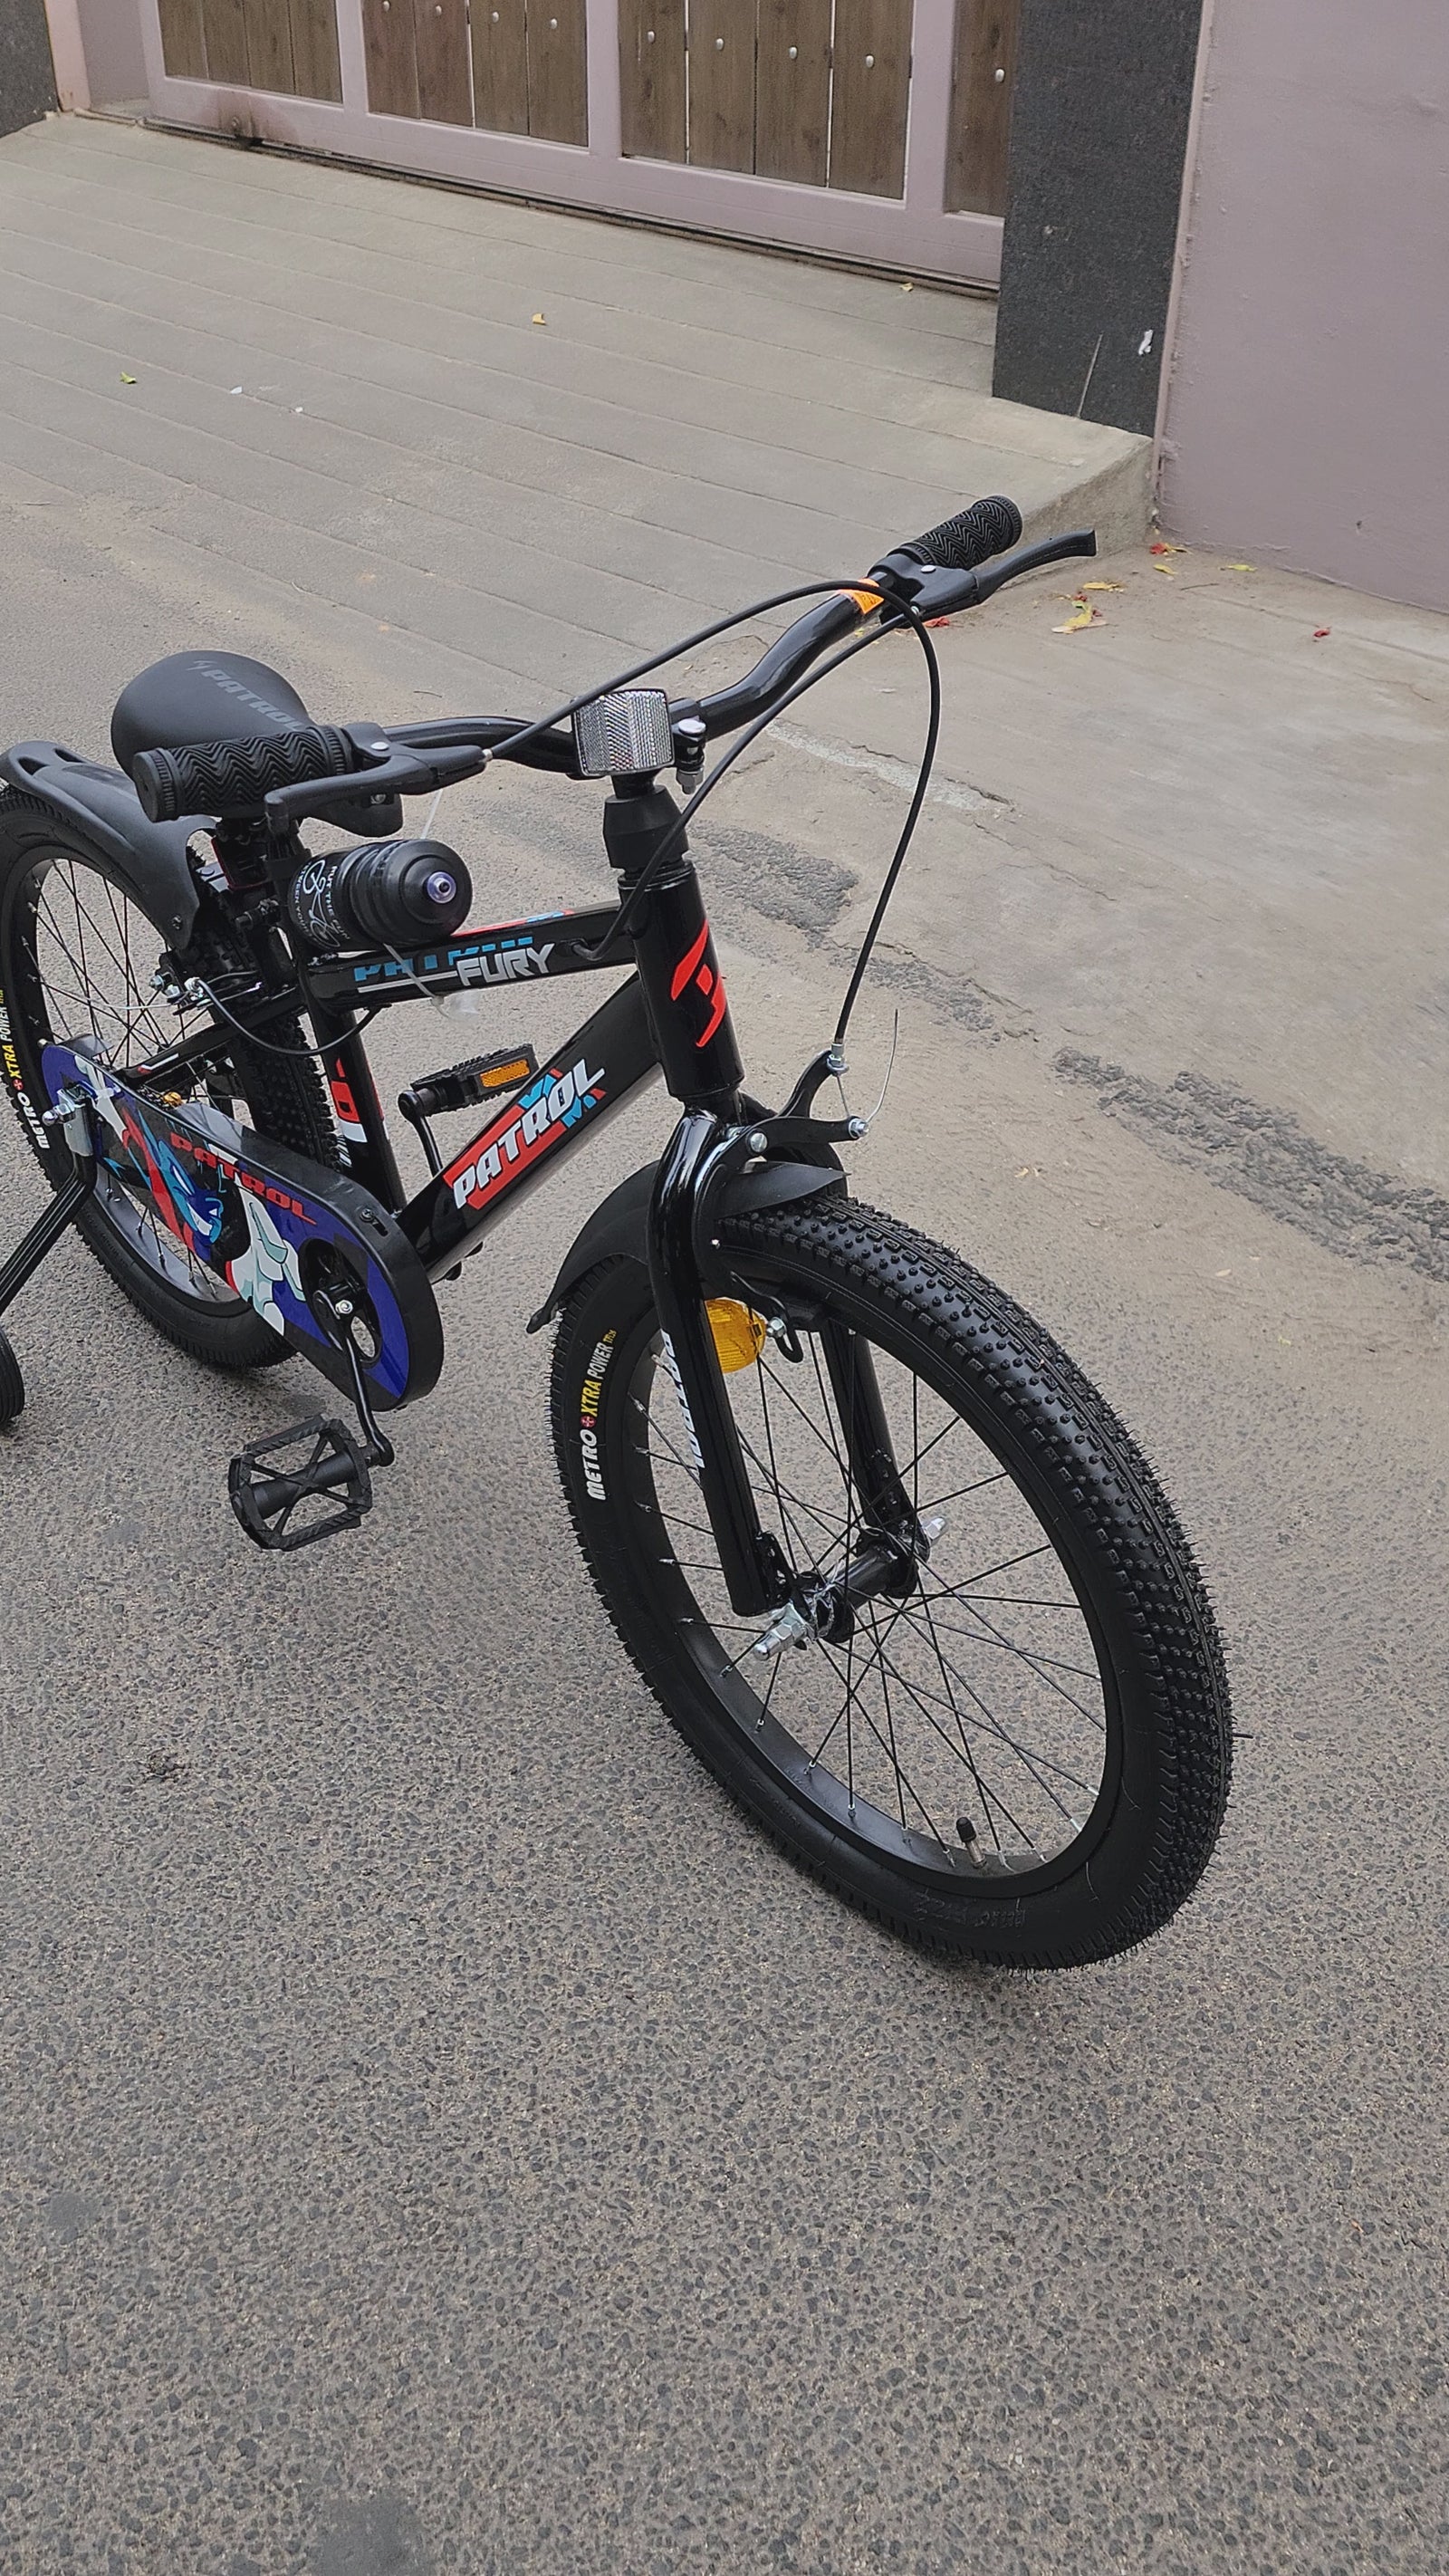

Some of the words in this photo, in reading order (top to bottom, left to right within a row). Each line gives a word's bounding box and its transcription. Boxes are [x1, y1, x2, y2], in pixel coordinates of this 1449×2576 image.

[200, 668, 305, 732] PATROL
[325, 891, 336, 917] THE
[331, 918, 351, 940] FUN
[456, 942, 556, 987] FURY
[2, 1043, 24, 1080] XTRA
[16, 1091, 51, 1149] METRO
[452, 1058, 606, 1210] PATROL
[169, 1131, 317, 1226] PATROL
[586, 1341, 615, 1380] POWER
[580, 1378, 602, 1418] XTRA
[579, 1428, 608, 1502] METRO
